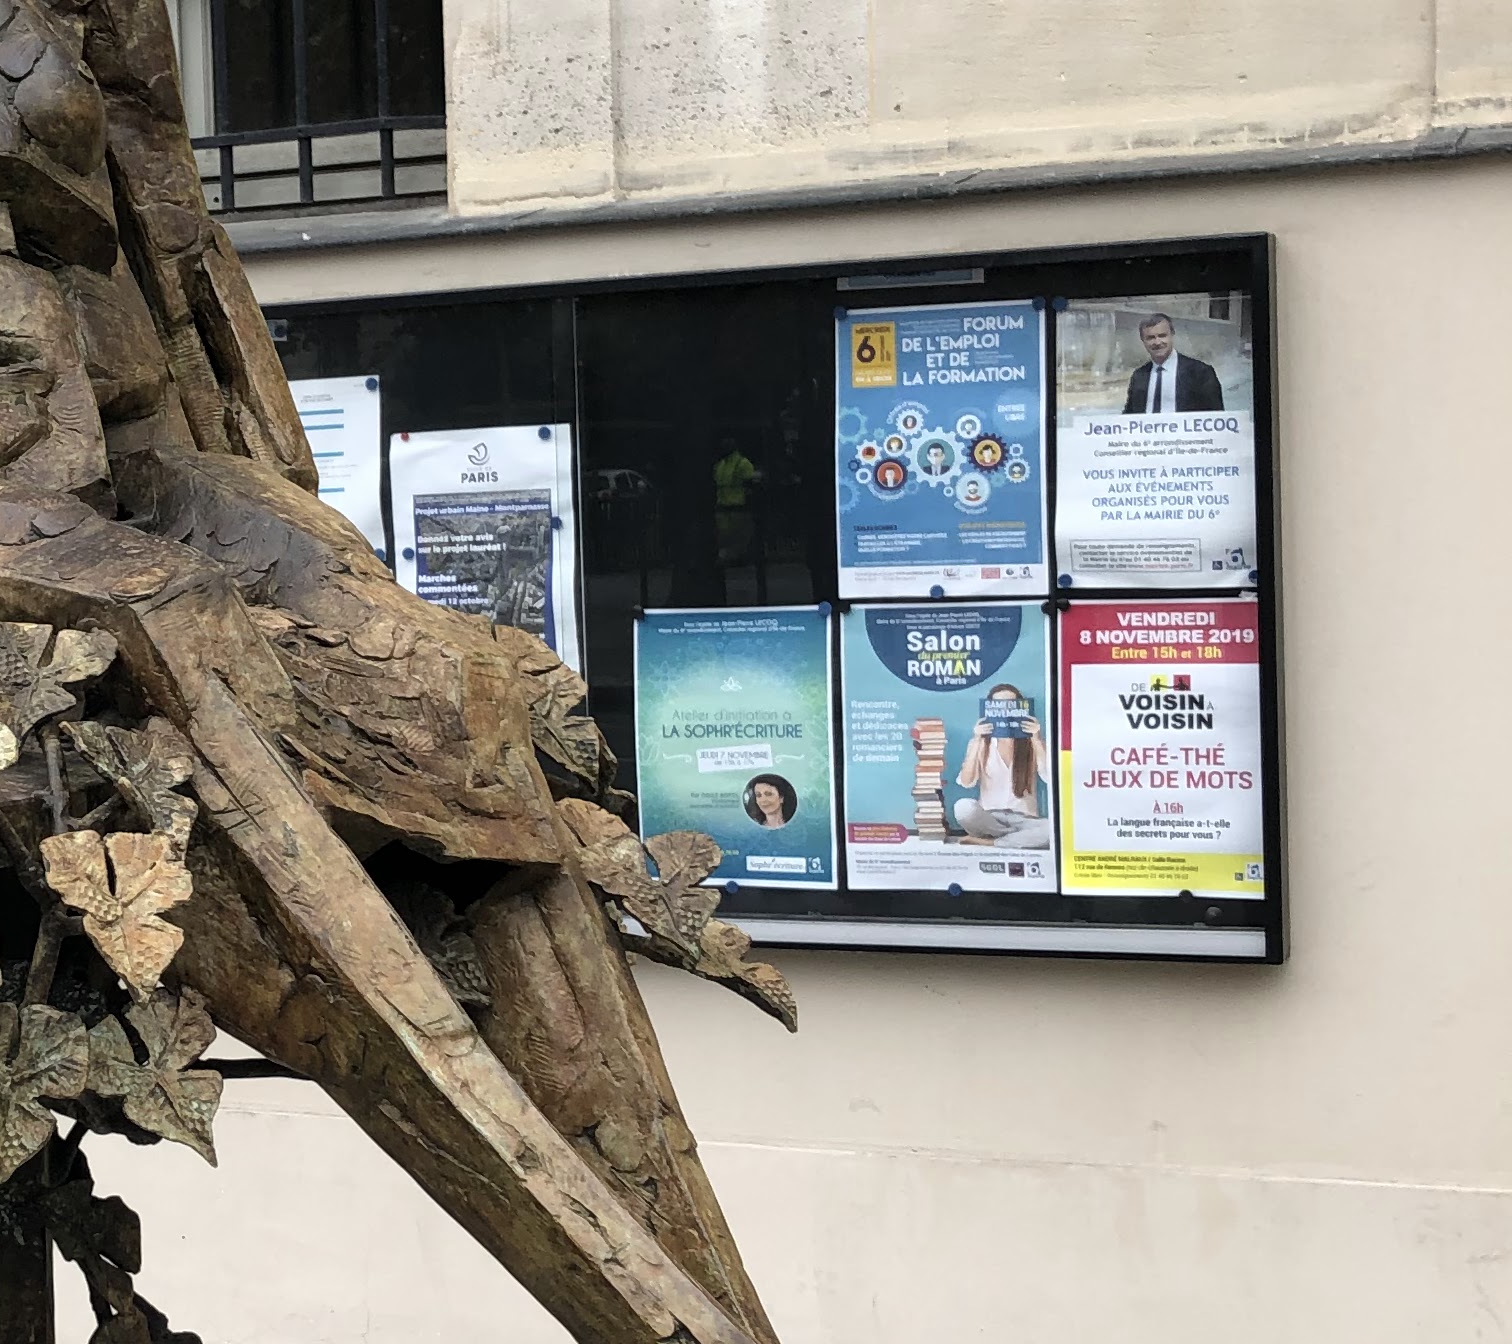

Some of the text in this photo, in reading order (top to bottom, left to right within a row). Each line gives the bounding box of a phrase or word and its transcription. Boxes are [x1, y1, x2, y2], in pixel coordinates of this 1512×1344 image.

[963, 315, 1024, 332] FORUM
[902, 333, 1000, 352] DE L'EMPLOI
[857, 335, 876, 363] 6
[926, 353, 944, 368] ET
[949, 352, 970, 367] DE
[902, 370, 924, 386] LA
[928, 365, 1026, 385] FORMATION
[1083, 417, 1240, 436] Jean-Pierre LECOQ
[461, 471, 499, 483] PARIS
[1083, 466, 1240, 480] VOUS INVITE À PARTICIPER
[1108, 483, 1131, 493] AUX
[1092, 494, 1230, 507] ORGANISÉS POUR VOUS
[415, 506, 438, 517] Projet
[439, 505, 464, 514] urbain
[466, 505, 489, 513] Maine
[1100, 510, 1123, 520] PAR
[1127, 510, 1141, 520] LA
[1144, 510, 1183, 520] MAIRIE
[1187, 509, 1204, 519] DU
[417, 533, 493, 544] Donnez votre avis
[417, 546, 431, 554] sur
[432, 545, 441, 553] le
[442, 543, 468, 555] projet
[418, 574, 457, 583] Marches
[418, 583, 478, 594] commentées
[459, 596, 488, 605] octobre
[1117, 612, 1216, 626] VENDREDI
[906, 629, 981, 652] Salon
[1079, 629, 1255, 645] 8 NOVEMBRE 2019
[1112, 646, 1222, 659] Entre 15h et 18h
[907, 659, 981, 677] ROMAN
[936, 676, 967, 685] à Paris
[1131, 683, 1146, 692] DE
[985, 700, 1017, 709] SAMEDI
[1118, 694, 1205, 710] VOISIN
[672, 709, 709, 721] Atelier
[714, 709, 777, 721] d'initiation
[984, 708, 1030, 717] NOVEMBRE
[851, 722, 861, 730] et
[1126, 713, 1214, 729] VOISIN
[662, 725, 680, 738] LA
[852, 733, 873, 741] avec
[852, 743, 903, 751] romanciers
[728, 750, 768, 759] NOVEMBRE
[852, 754, 864, 762] de
[1110, 743, 1225, 766] CAFÉ-THÉ
[1083, 770, 1254, 789] JEUX DE MOTS
[1153, 800, 1184, 813] À 16h
[1107, 817, 1231, 830] La langue française a-t-elle
[1117, 828, 1132, 838] des
[1135, 830, 1168, 838] secrets
[1170, 831, 1190, 840] pour
[1216, 830, 1221, 840] ?
